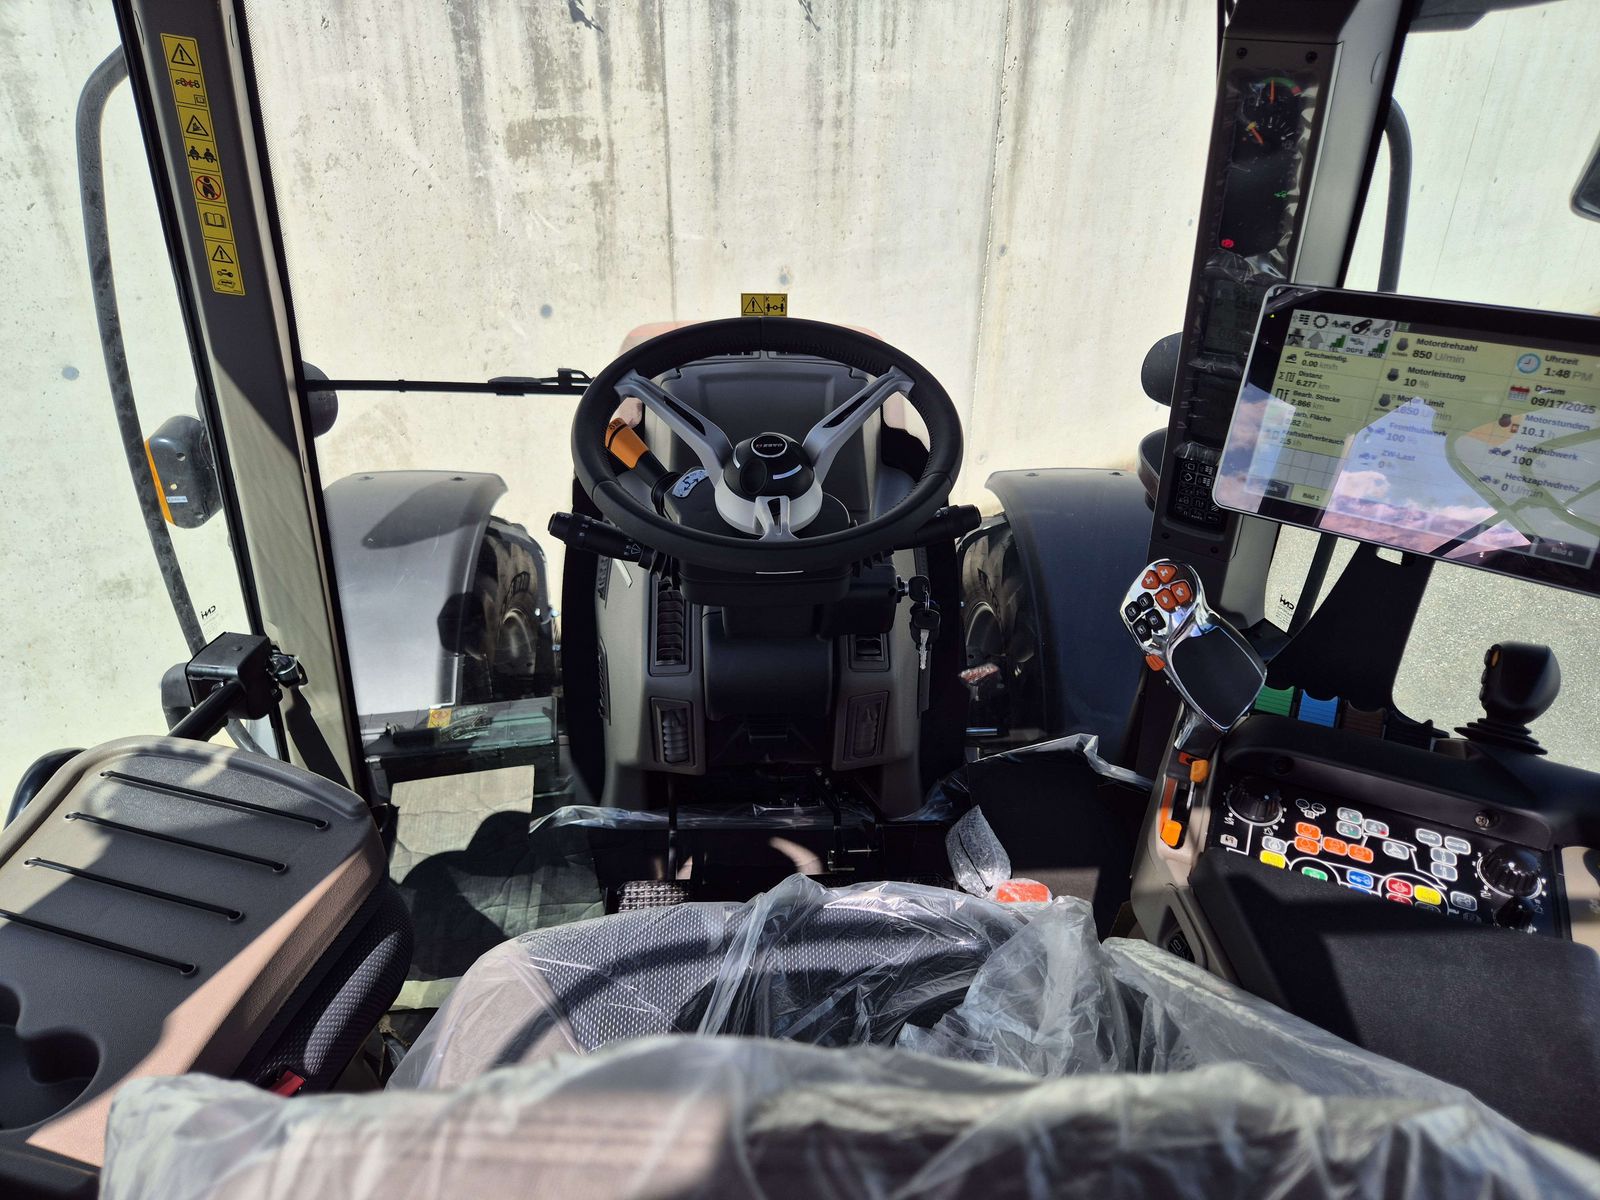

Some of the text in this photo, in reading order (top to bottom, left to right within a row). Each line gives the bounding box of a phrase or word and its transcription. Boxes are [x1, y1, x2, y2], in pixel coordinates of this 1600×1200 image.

[1384, 328, 1391, 338] 8
[1416, 338, 1478, 352] Motordrehzahl
[1412, 349, 1433, 360] 850
[1434, 352, 1465, 364] U/min
[1544, 354, 1579, 366] Uhrzeit
[1302, 359, 1318, 368] 0.00
[1298, 370, 1323, 379] Distanz
[1407, 366, 1466, 382] Motorleistung
[1544, 367, 1594, 382] 1:48 PM
[1296, 379, 1330, 390] 6.277 km
[1403, 378, 1417, 387] 10
[1534, 384, 1566, 396] Datum
[1292, 390, 1341, 403] Bearb. Strecke
[1424, 398, 1445, 408] Limit
[1530, 396, 1597, 415] 09/17/2025
[1310, 413, 1332, 422] Fläche
[1525, 414, 1591, 431] Motorstunden
[1389, 421, 1447, 437] Fronthubwerk
[1521, 426, 1545, 438] 10.1
[1386, 432, 1405, 443] 100
[1515, 443, 1579, 461] Heckhubwerk
[1511, 455, 1533, 467] 100
[1501, 483, 1508, 492] 0
